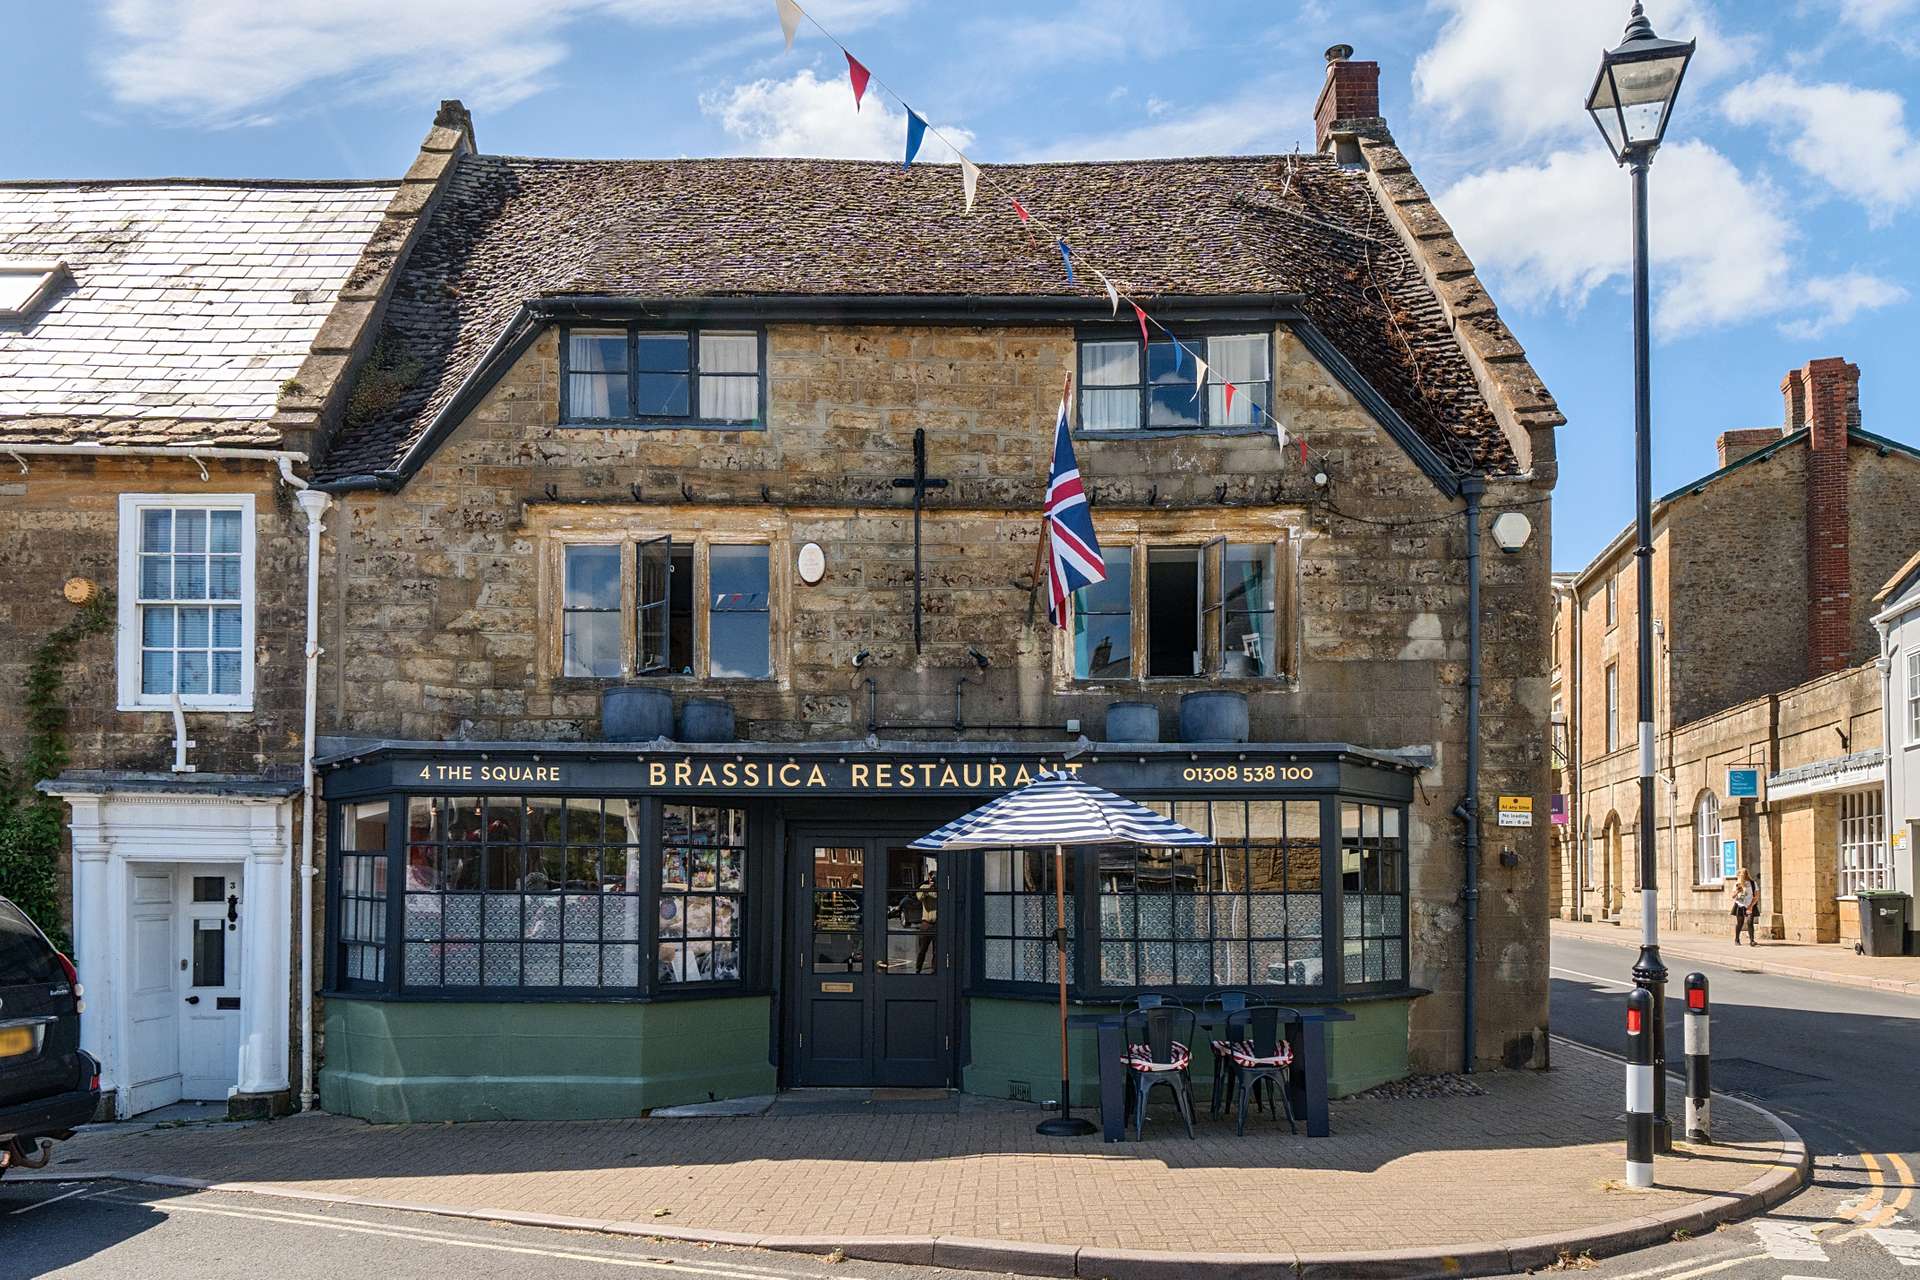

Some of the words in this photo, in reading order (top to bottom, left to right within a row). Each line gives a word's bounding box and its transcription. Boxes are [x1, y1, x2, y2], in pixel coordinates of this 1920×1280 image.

[419, 765, 431, 780] 4
[436, 765, 473, 780] THE
[480, 766, 560, 782] SQUARE
[649, 763, 827, 787] BRASSICA
[1183, 765, 1238, 783] 01308
[1243, 765, 1276, 783] 538
[1280, 767, 1313, 780] 100
[229, 881, 236, 890] 3
